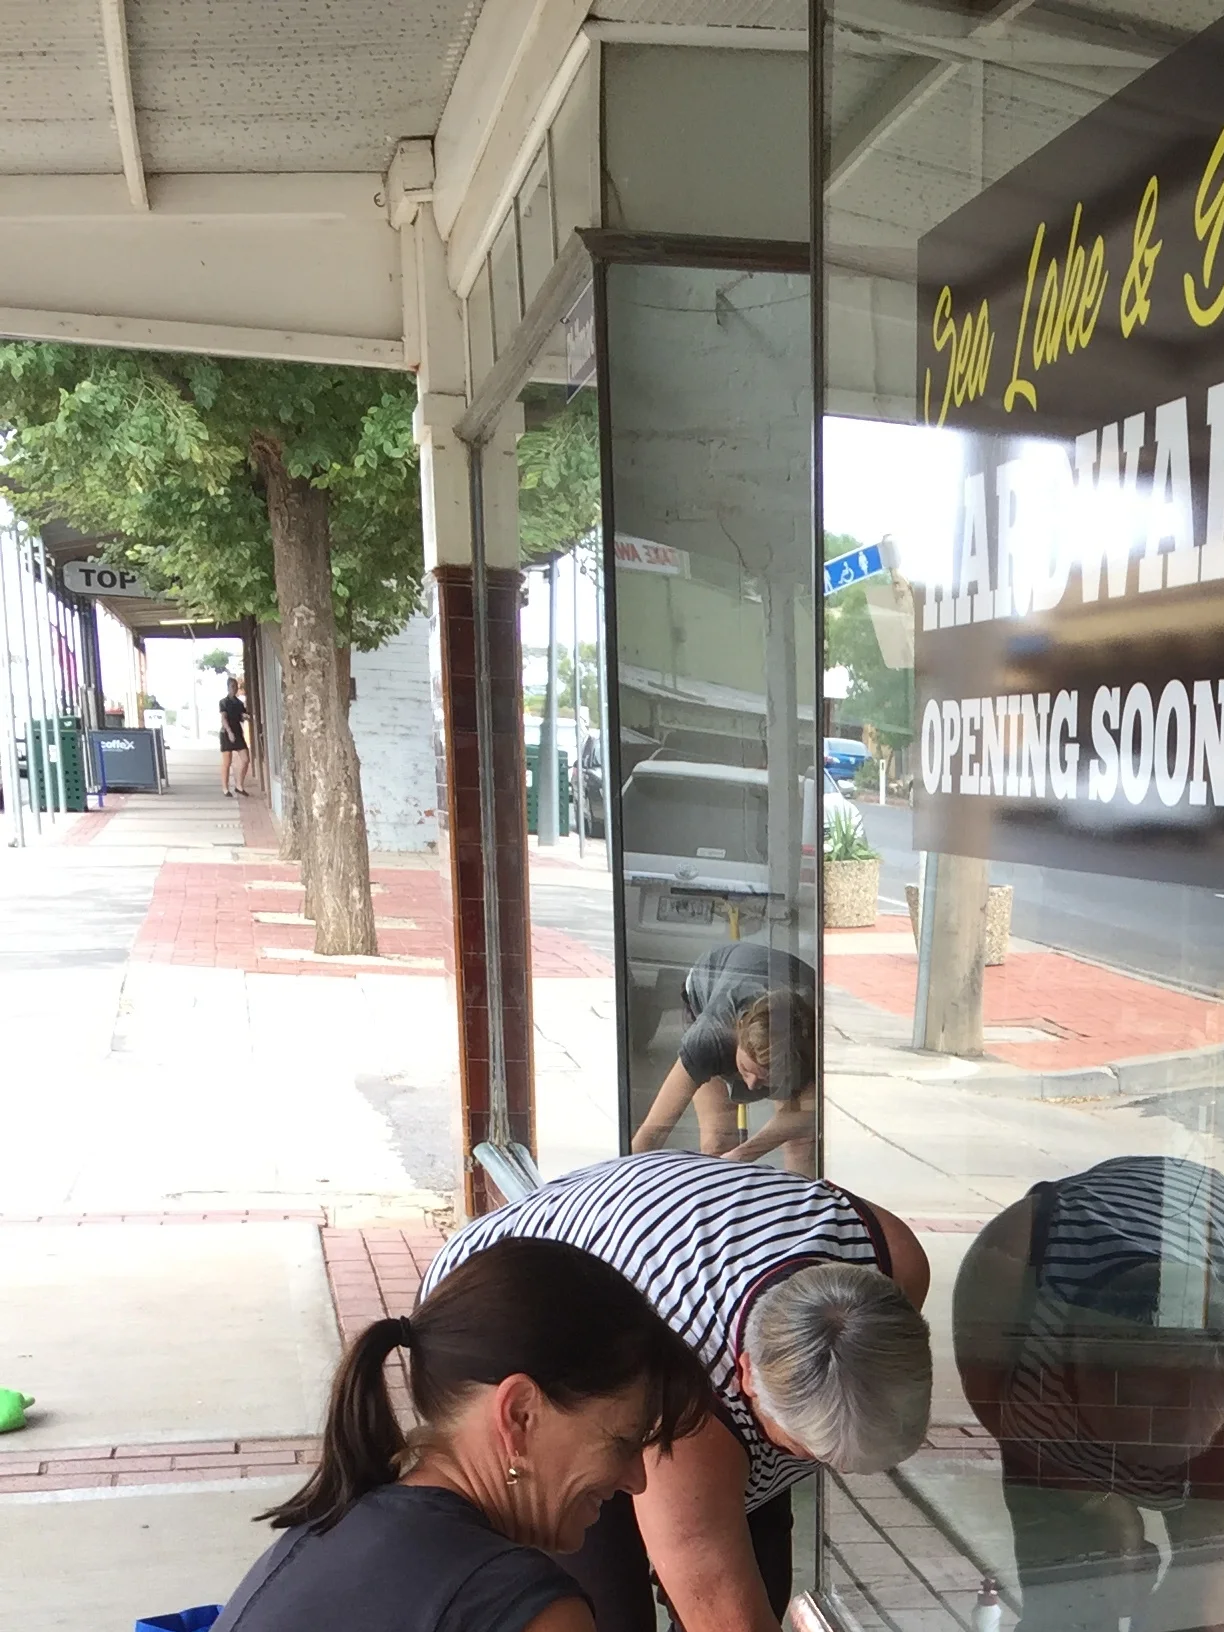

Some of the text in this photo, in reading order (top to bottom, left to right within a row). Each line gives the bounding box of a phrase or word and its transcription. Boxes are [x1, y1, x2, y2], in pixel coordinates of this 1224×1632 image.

[925, 285, 995, 430] Sea
[1004, 202, 1108, 412] Lake
[1120, 175, 1162, 338] &
[920, 689, 1080, 800] OPENING
